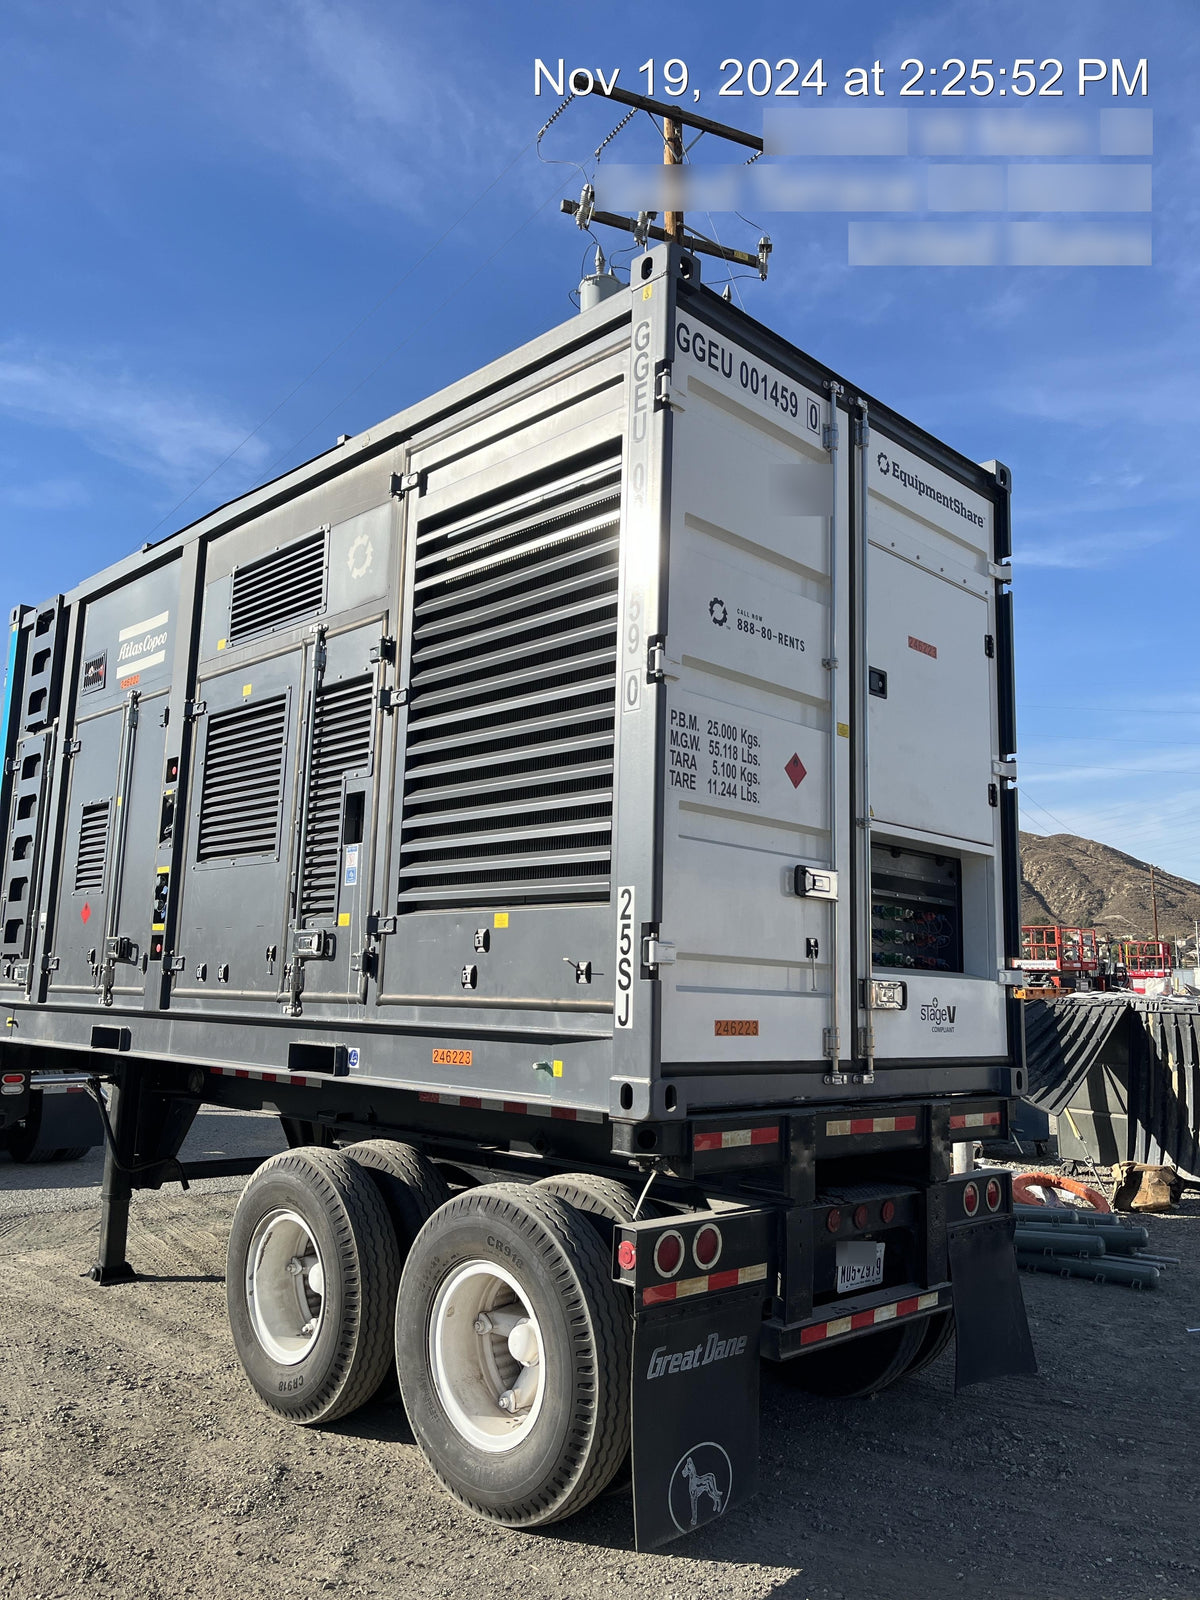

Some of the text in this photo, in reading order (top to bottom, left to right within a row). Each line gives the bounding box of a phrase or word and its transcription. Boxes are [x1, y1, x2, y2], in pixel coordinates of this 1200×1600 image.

[632, 320, 651, 444] GGEU
[676, 322, 733, 379] GGEU
[739, 361, 798, 418] 001459
[891, 461, 984, 528] EquipmentShare
[117, 631, 168, 662] Atlas Copco
[737, 618, 805, 652] 888-80-RENTS
[670, 708, 761, 749] P.B.M. 25.000 Kgs.
[670, 729, 761, 767] M.G.W. 55.118 Lbs.
[669, 749, 761, 787] TARA 5.100 Kgs.
[669, 769, 760, 804] TARE 11.244 Lbs.
[617, 888, 632, 1027] 25SJ
[715, 1020, 759, 1036] 246223
[433, 1049, 471, 1065] 246223
[646, 1332, 748, 1380] Great Dane
